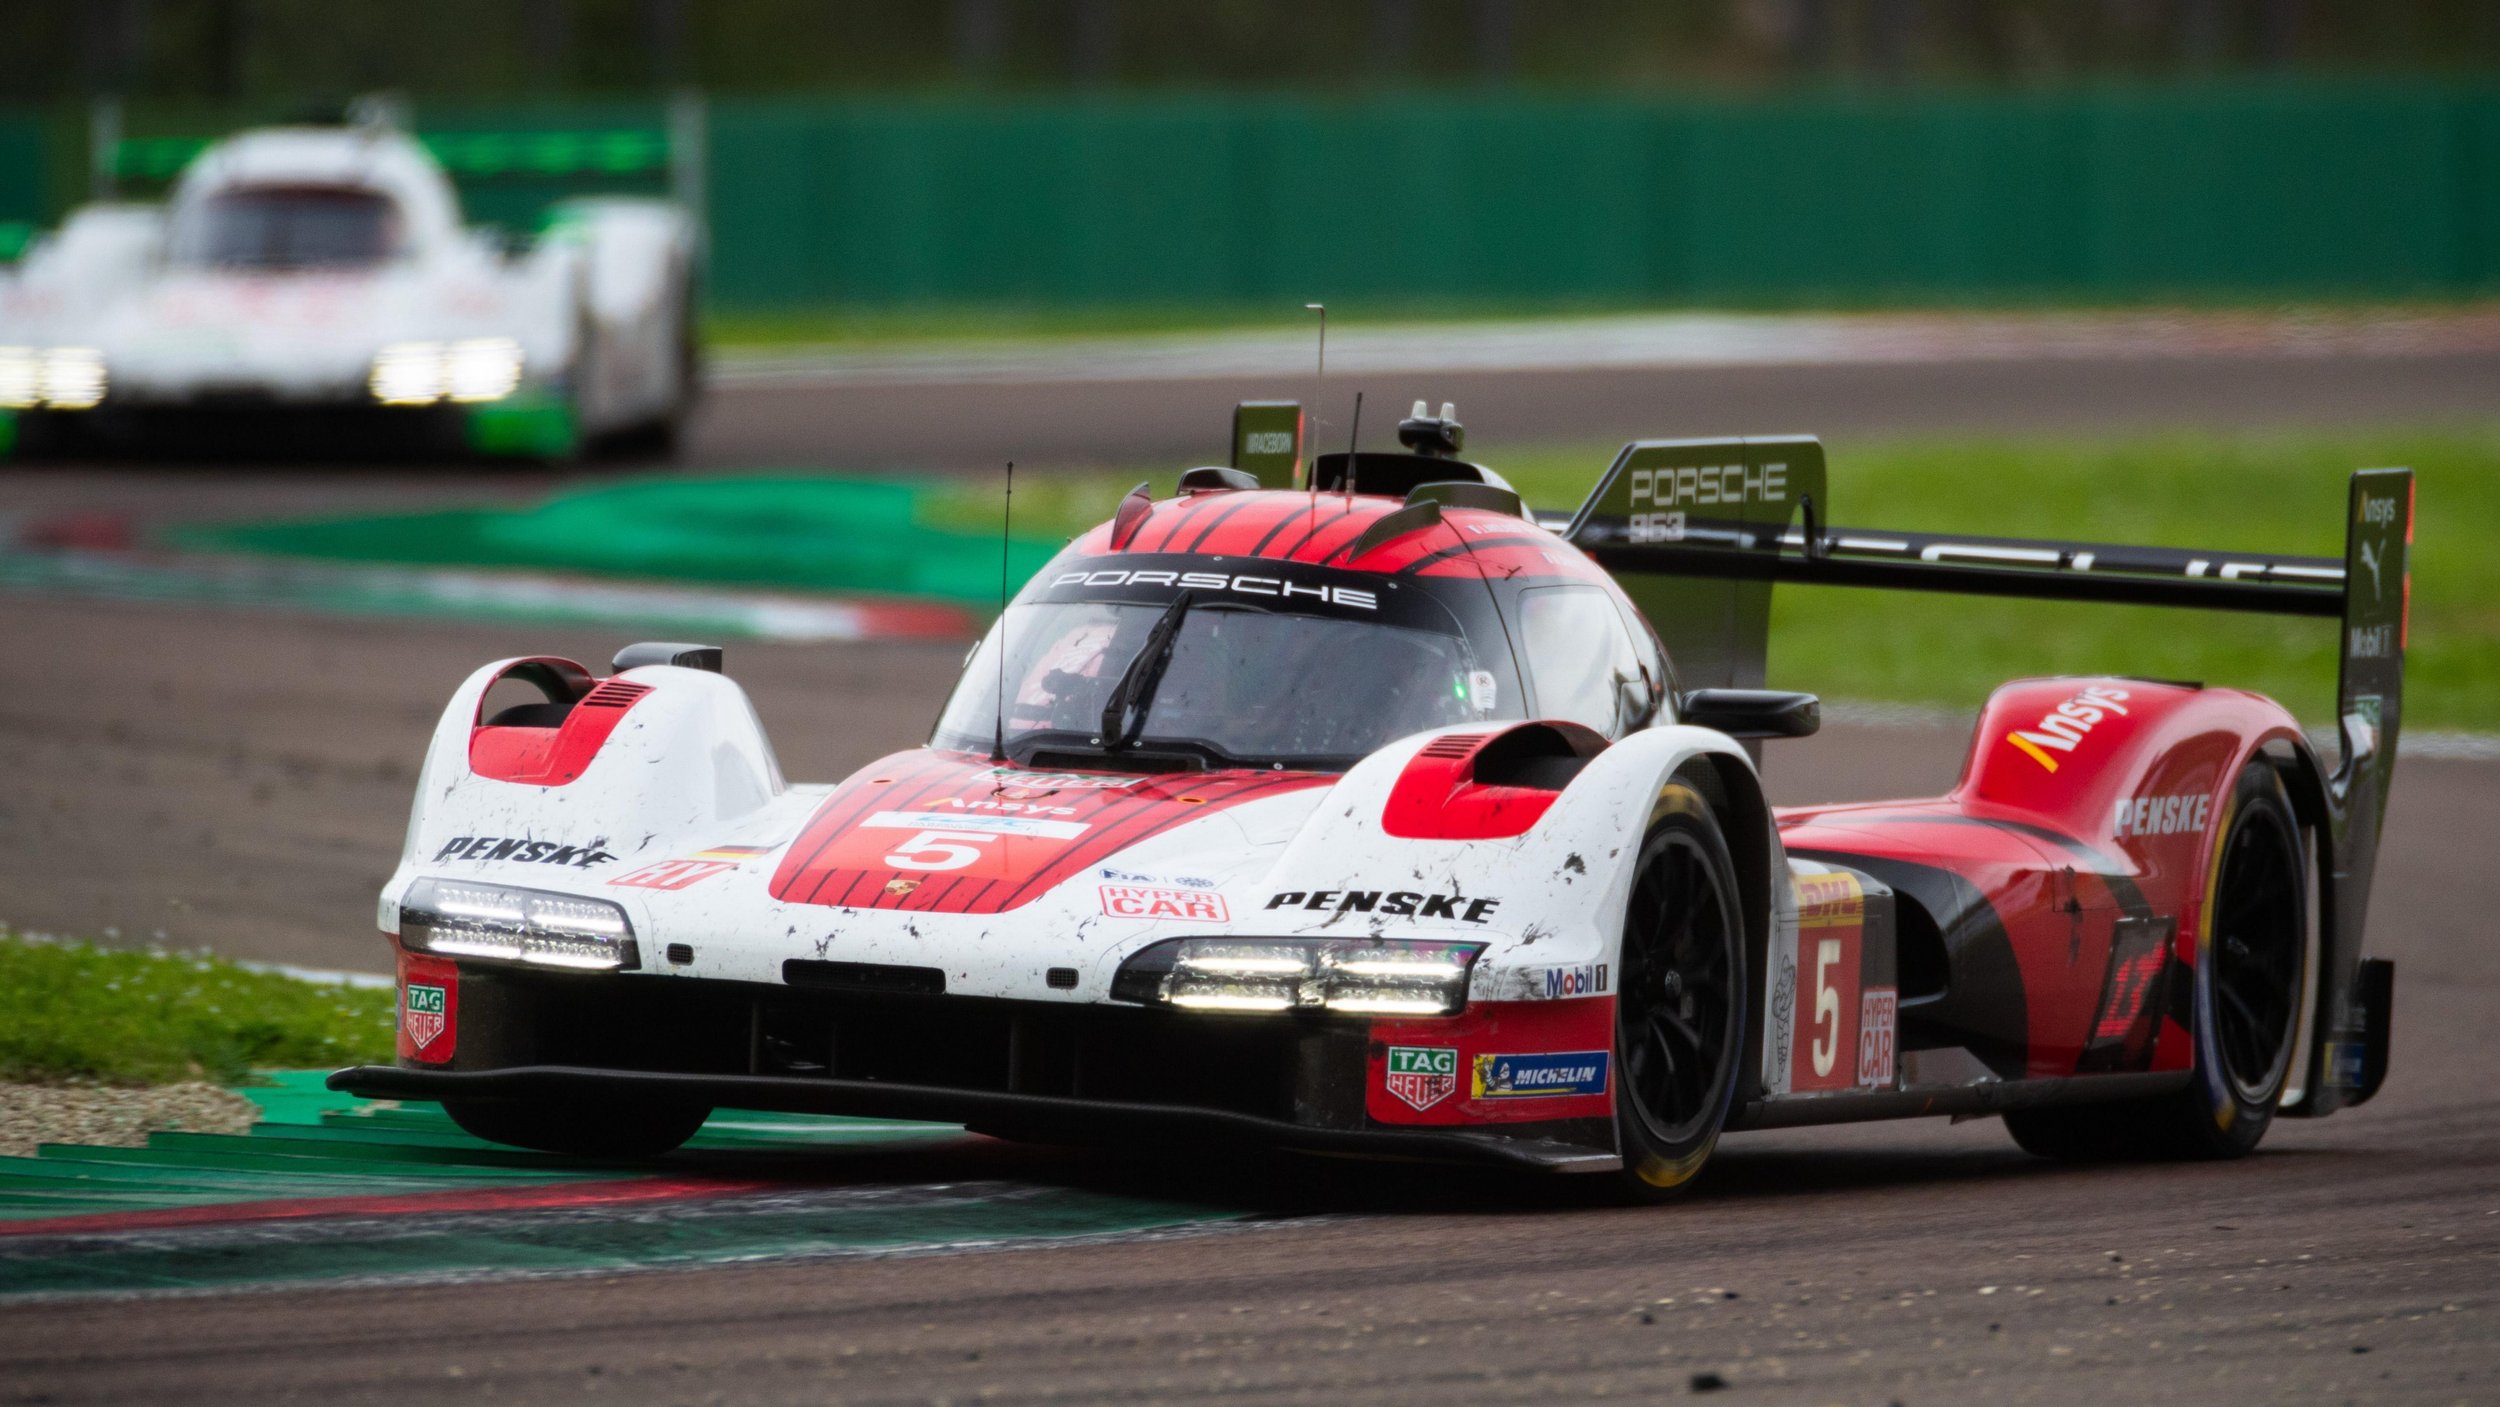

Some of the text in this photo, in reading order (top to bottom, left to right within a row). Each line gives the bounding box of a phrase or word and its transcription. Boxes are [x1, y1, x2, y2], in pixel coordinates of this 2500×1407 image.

[1630, 463, 1787, 507] PORSCHE
[1630, 511, 1685, 543] 963
[1050, 571, 1378, 610] PORSCHE
[2006, 687, 2130, 773] Ansys
[924, 797, 1077, 815] Ansys
[2114, 795, 2210, 837] PENSKE
[432, 837, 619, 868] PENSKE
[884, 830, 998, 871] 5
[1109, 888, 1214, 903] HYPER
[1113, 898, 1218, 918] CAR
[1263, 891, 1501, 924] PENSKE
[1800, 880, 1857, 917] DHL
[1546, 964, 1607, 997] Mobil 1
[409, 990, 441, 1010] TAG
[1813, 939, 1841, 1078] 5
[1863, 997, 1893, 1027] HYPER
[408, 1013, 441, 1042] HEUER
[1395, 1052, 1451, 1072] TAG
[1861, 1030, 1892, 1078] CAR
[1391, 1075, 1453, 1105] HEUER
[1515, 1066, 1596, 1085] MICHELIN
